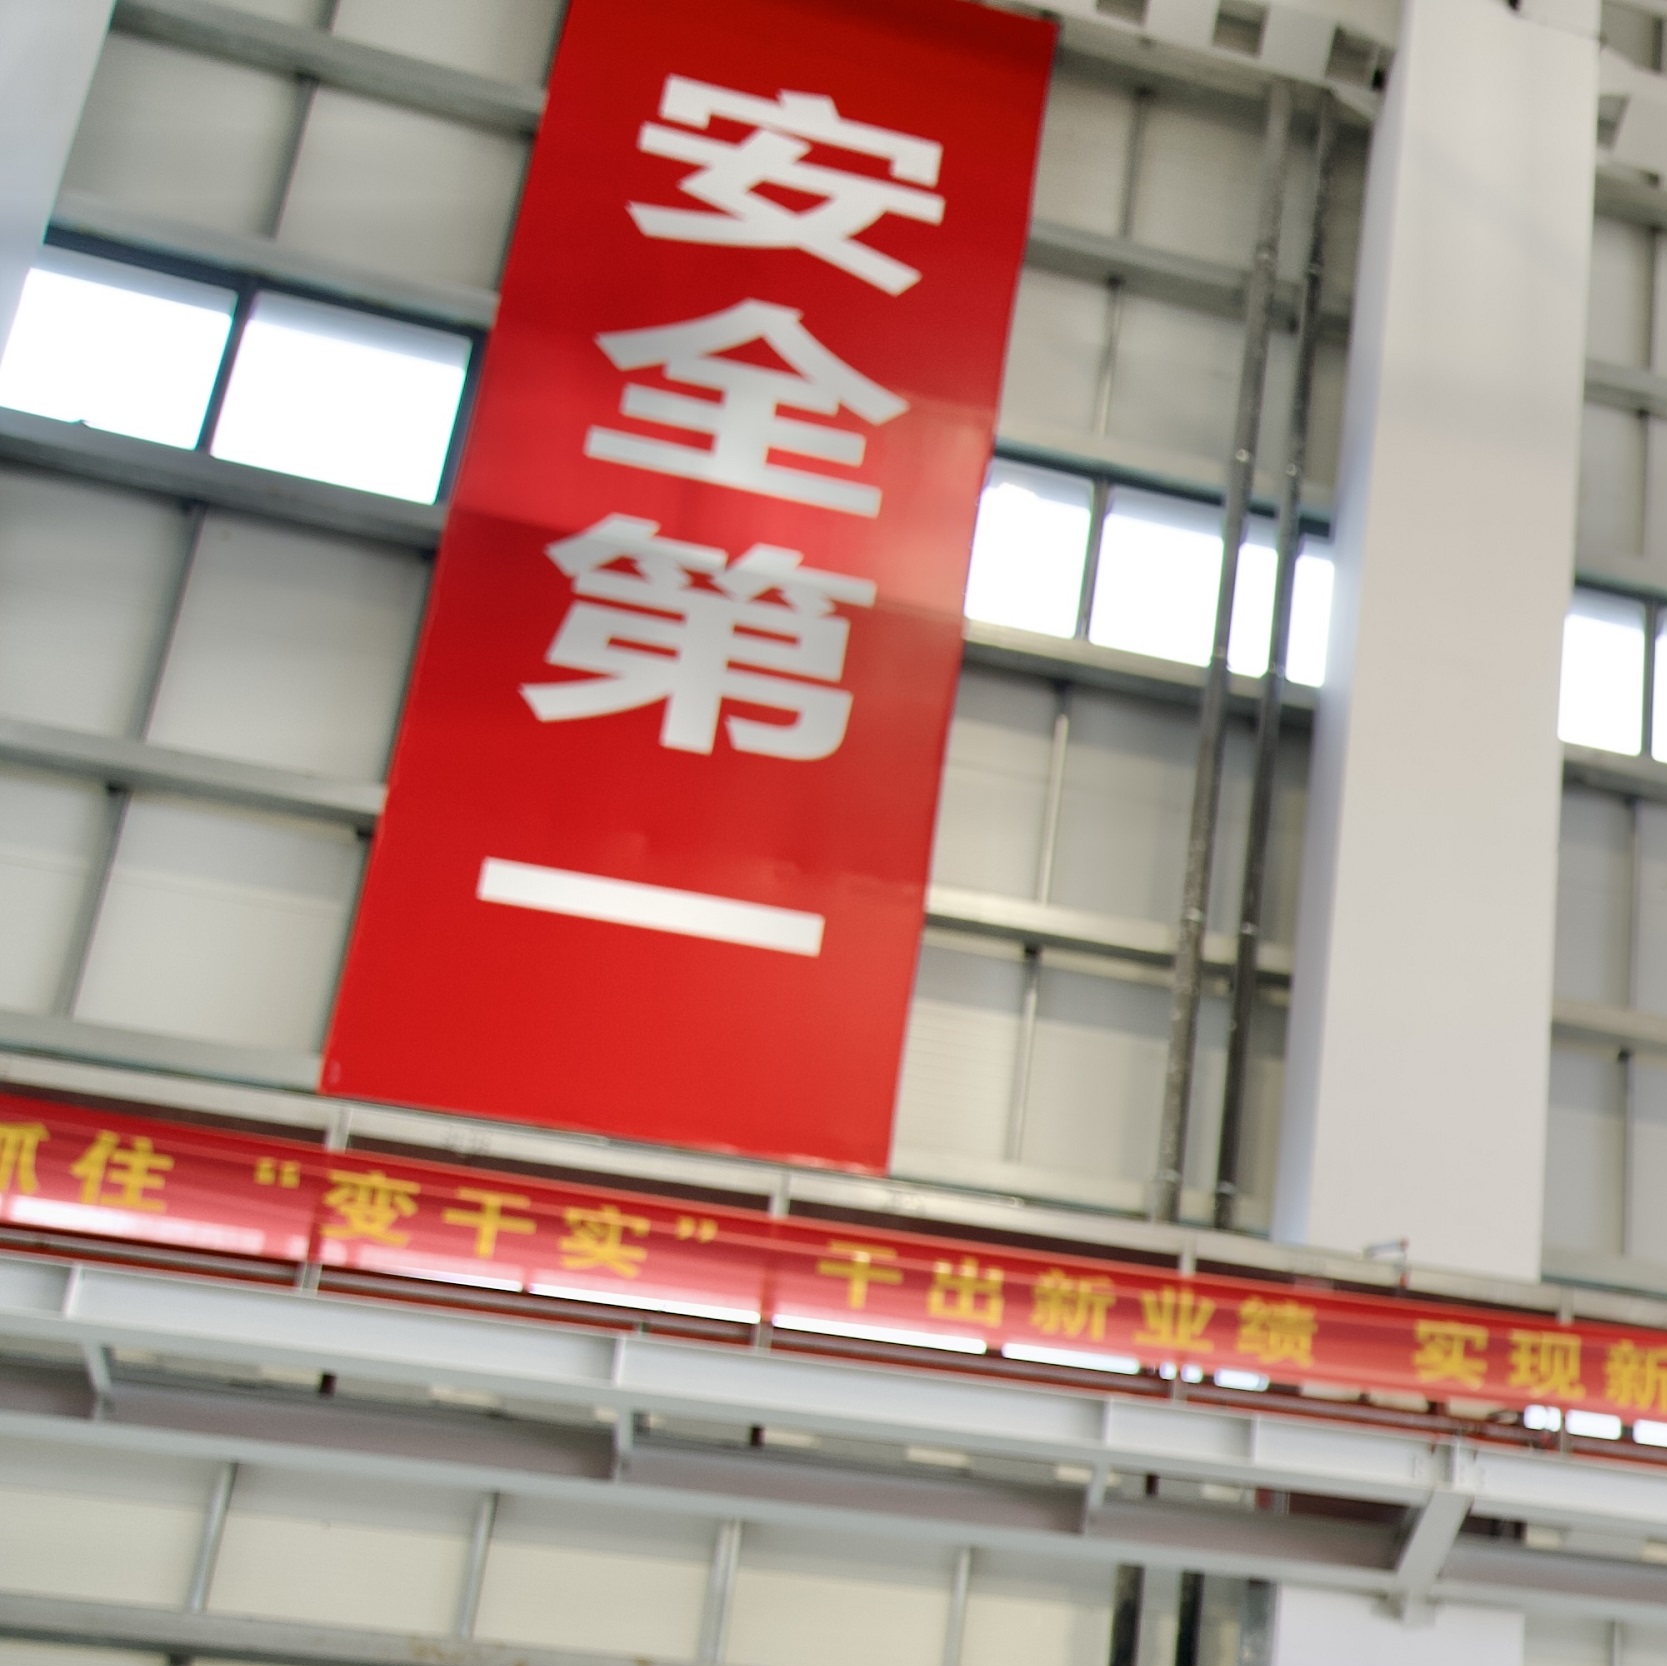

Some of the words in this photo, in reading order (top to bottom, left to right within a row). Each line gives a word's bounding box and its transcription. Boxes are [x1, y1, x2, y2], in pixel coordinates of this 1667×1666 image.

[476, 73, 945, 956] 安全第一
[817, 1240, 1318, 1369] 干出新业绩
